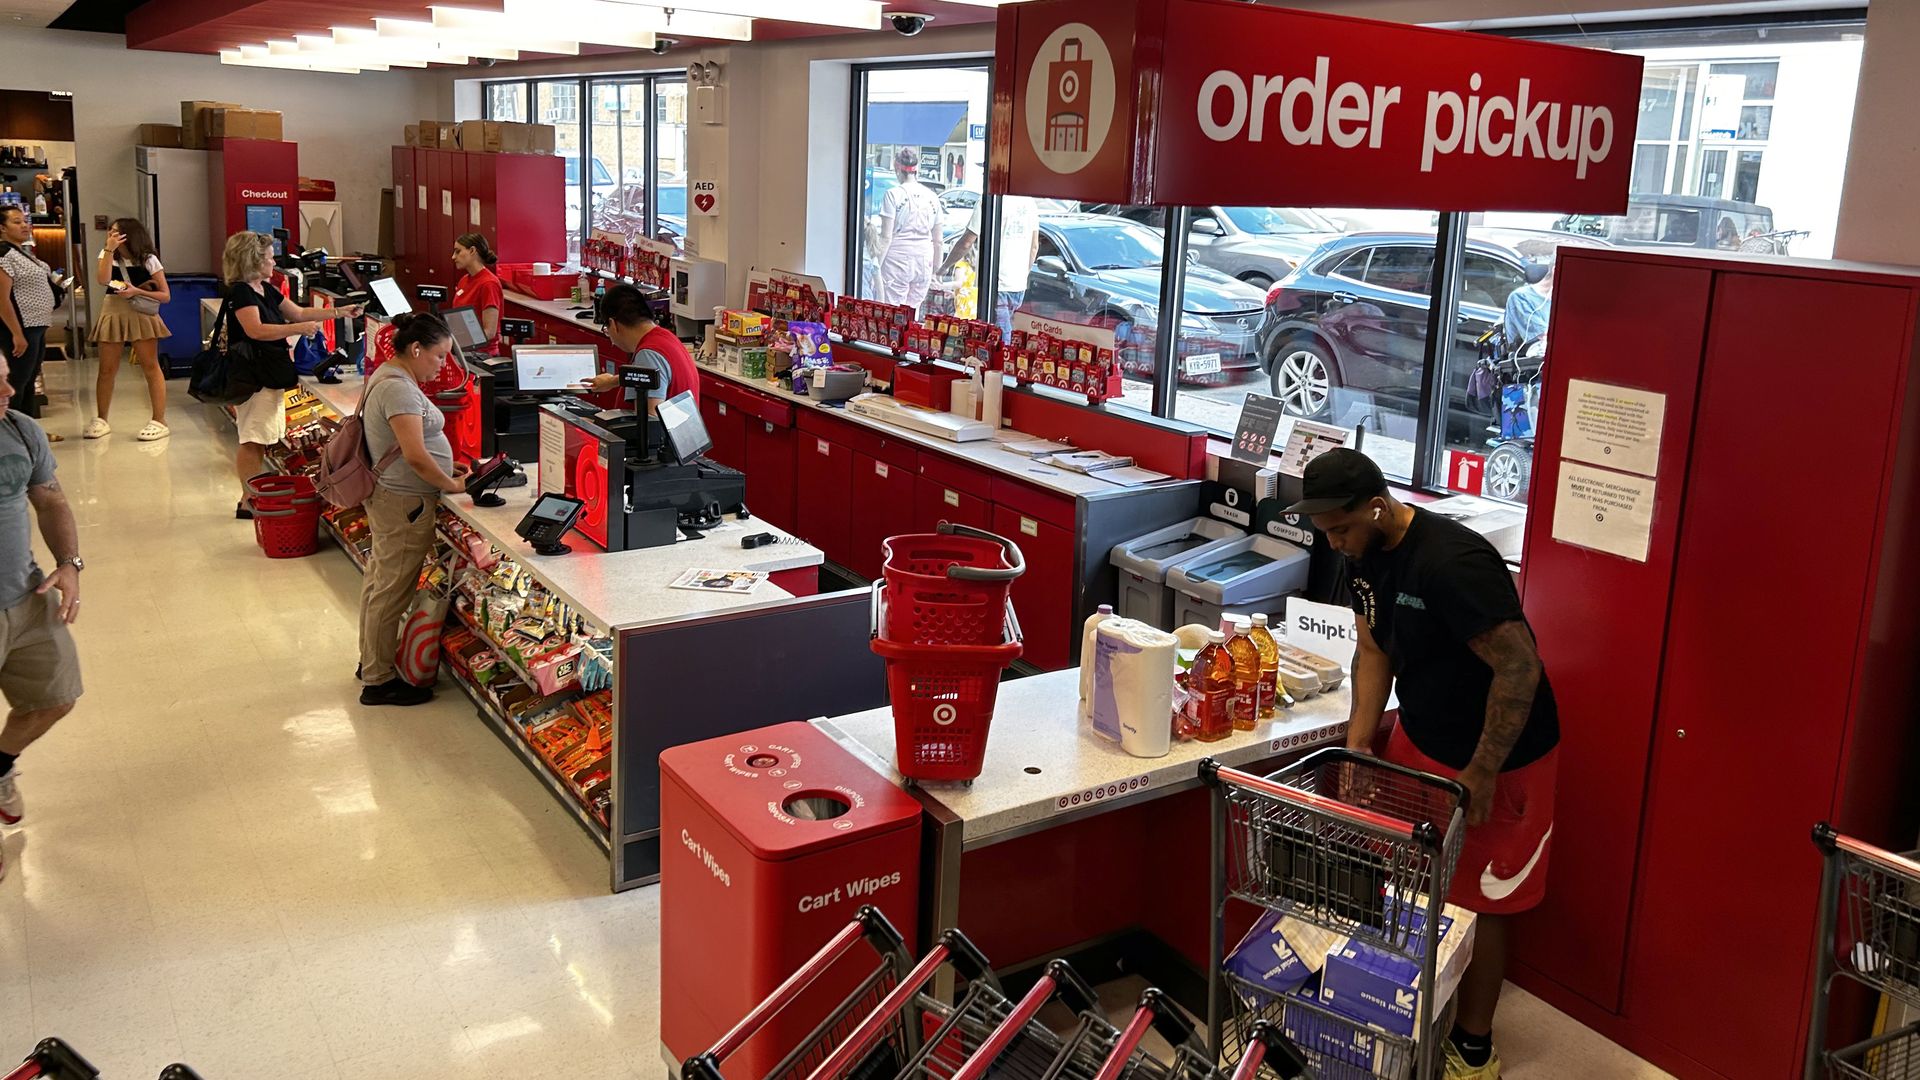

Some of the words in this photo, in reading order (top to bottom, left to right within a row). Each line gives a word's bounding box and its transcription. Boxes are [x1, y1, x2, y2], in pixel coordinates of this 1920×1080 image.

[1197, 56, 1401, 149] order
[1420, 72, 1614, 180] pickup
[695, 182, 714, 190] AED
[241, 189, 288, 199] Checkout
[1031, 320, 1042, 331] Gift
[1043, 323, 1062, 335] Cards
[1571, 483, 1585, 492] MUST
[1592, 488, 1617, 498] RETURNED
[1576, 477, 1604, 488] ELECTRONIC
[1605, 483, 1641, 496] MERCHANDISE
[1572, 491, 1586, 500] STORE
[1592, 496, 1603, 504] WAS
[1604, 499, 1633, 511] PURCHASED
[1224, 509, 1239, 518] TRASH
[1273, 526, 1298, 537] COMPOST
[1299, 616, 1345, 640] Shipt
[768, 744, 795, 754] CART
[681, 828, 701, 859] Cart
[702, 847, 730, 887] Wipes
[798, 887, 840, 913] Cart
[846, 871, 901, 898] Wipes
[1360, 992, 1386, 1009] tissue
[1388, 1004, 1412, 1019] facial
